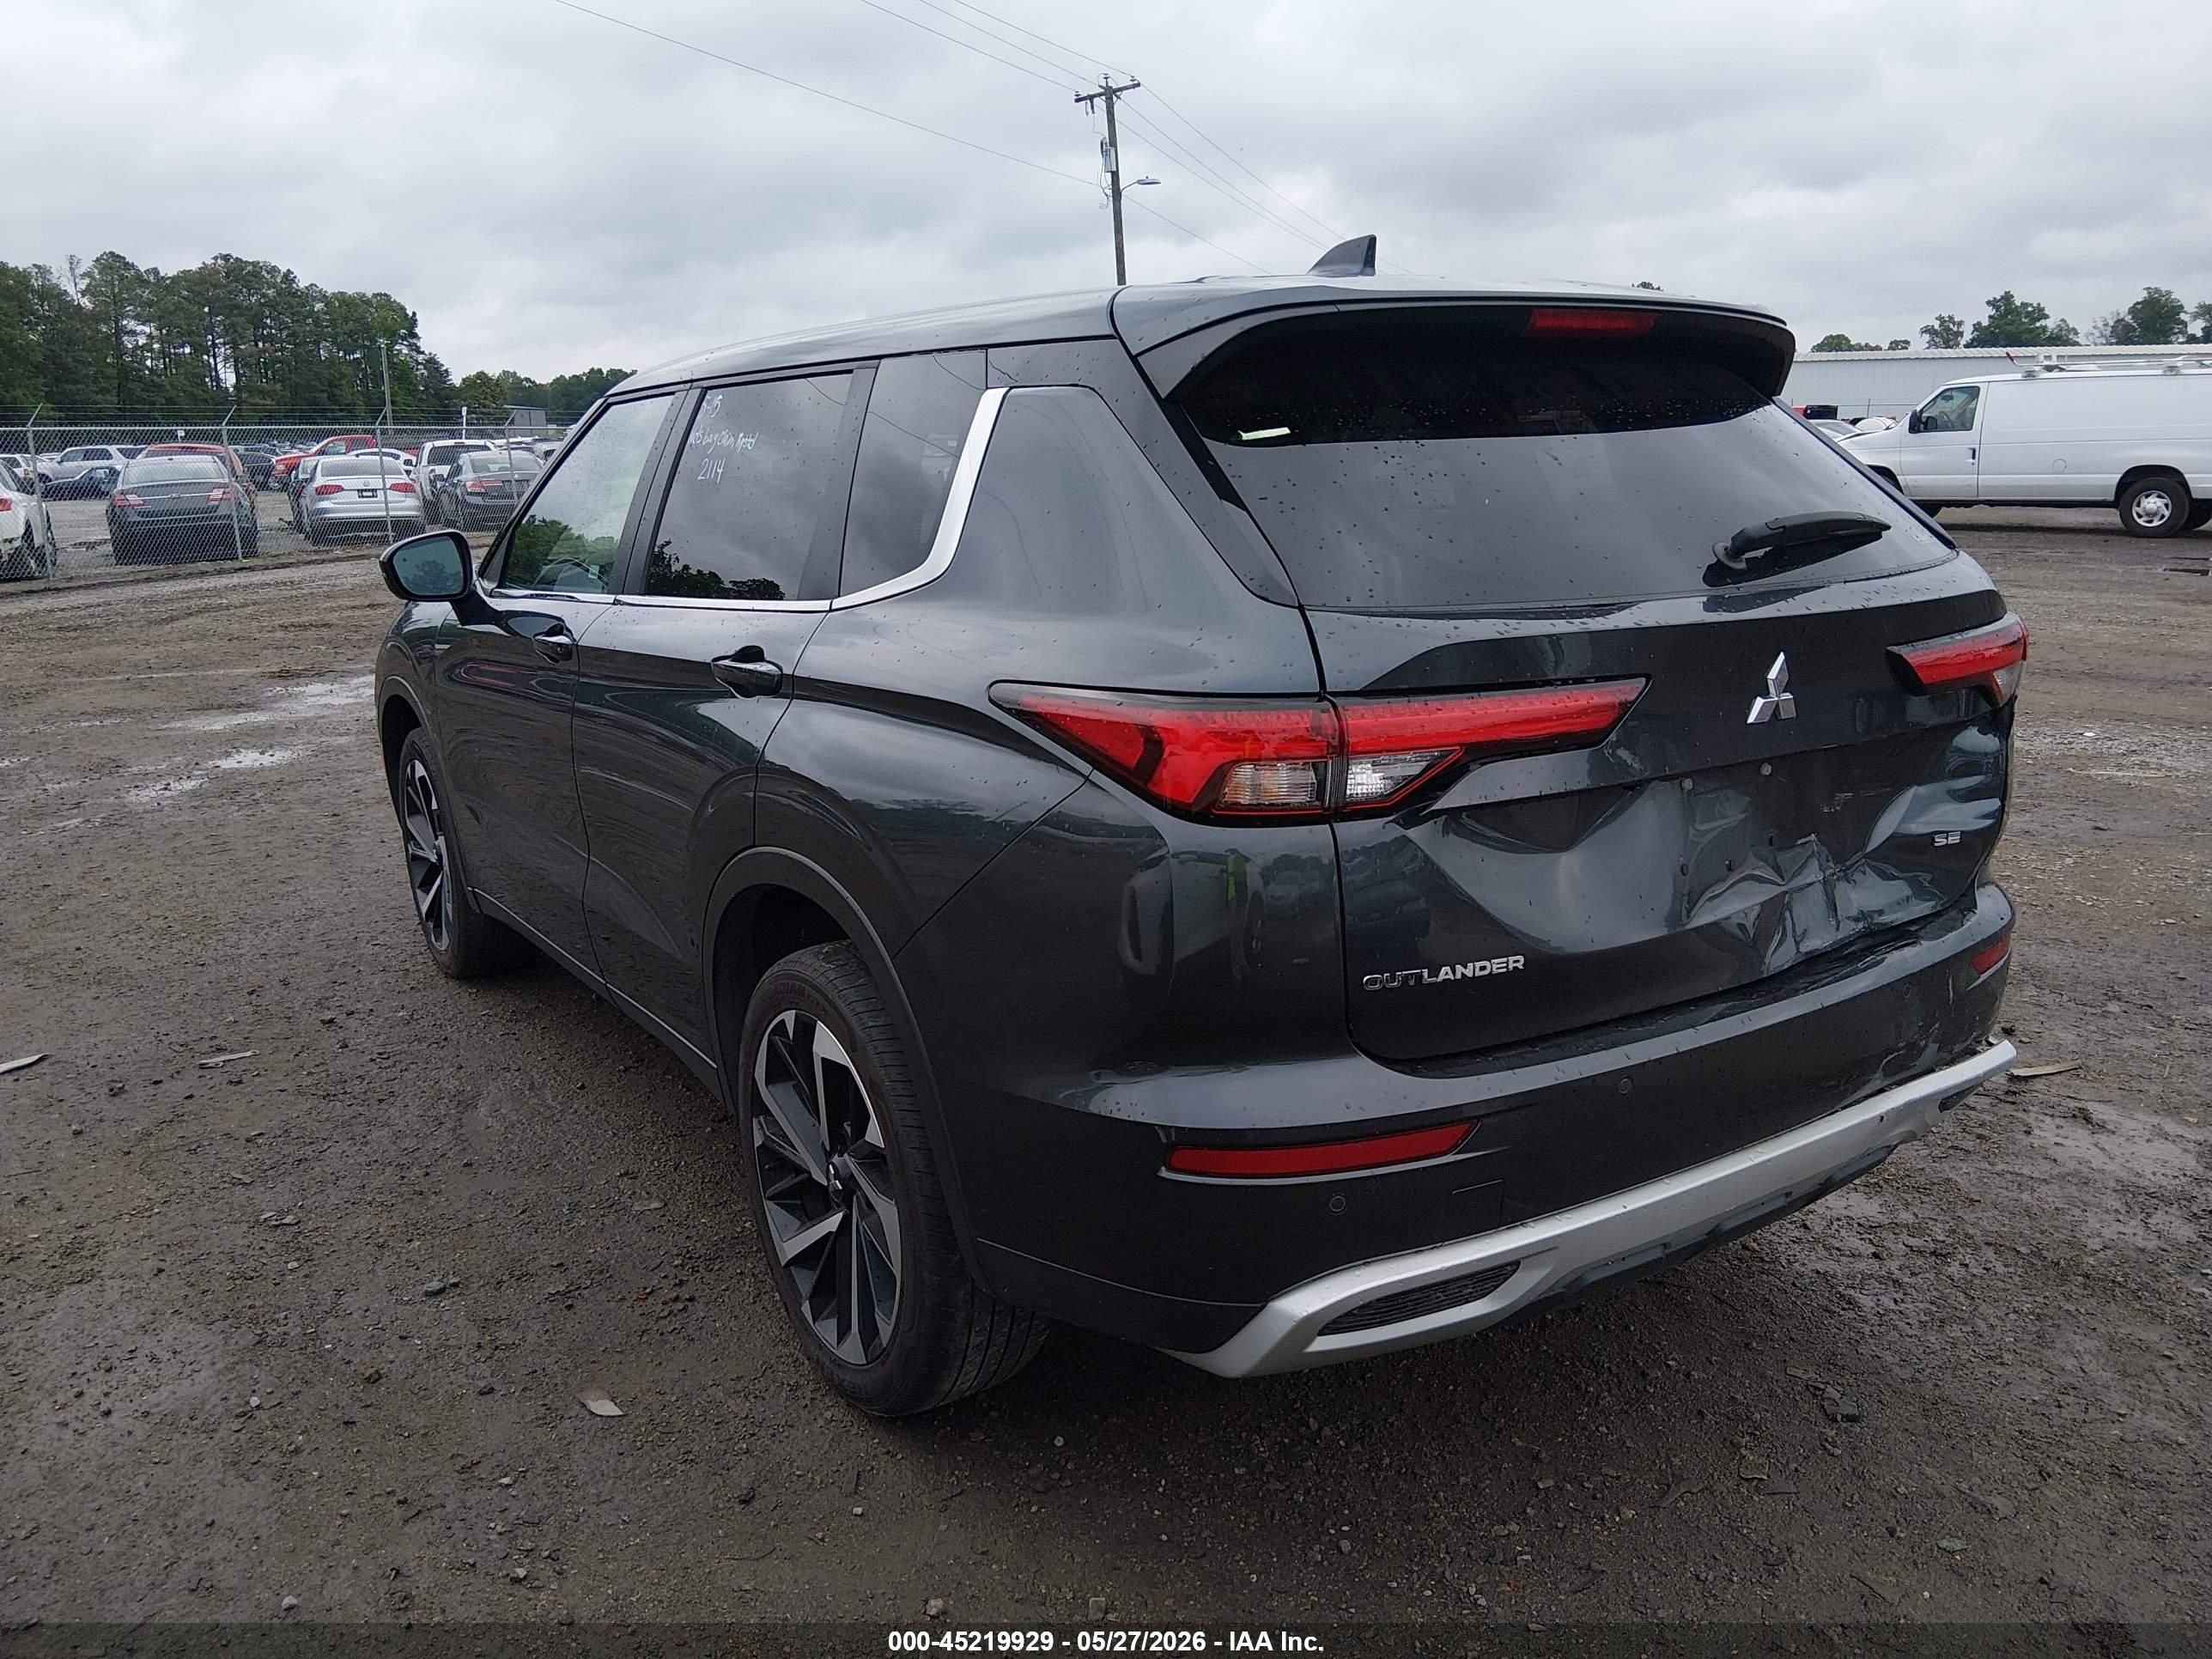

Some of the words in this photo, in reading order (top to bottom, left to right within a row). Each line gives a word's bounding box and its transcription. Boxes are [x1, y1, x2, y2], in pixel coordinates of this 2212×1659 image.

[697, 458, 726, 483] 2114
[1934, 831, 1961, 847] SE
[1363, 955, 1525, 991] OUTLANDER
